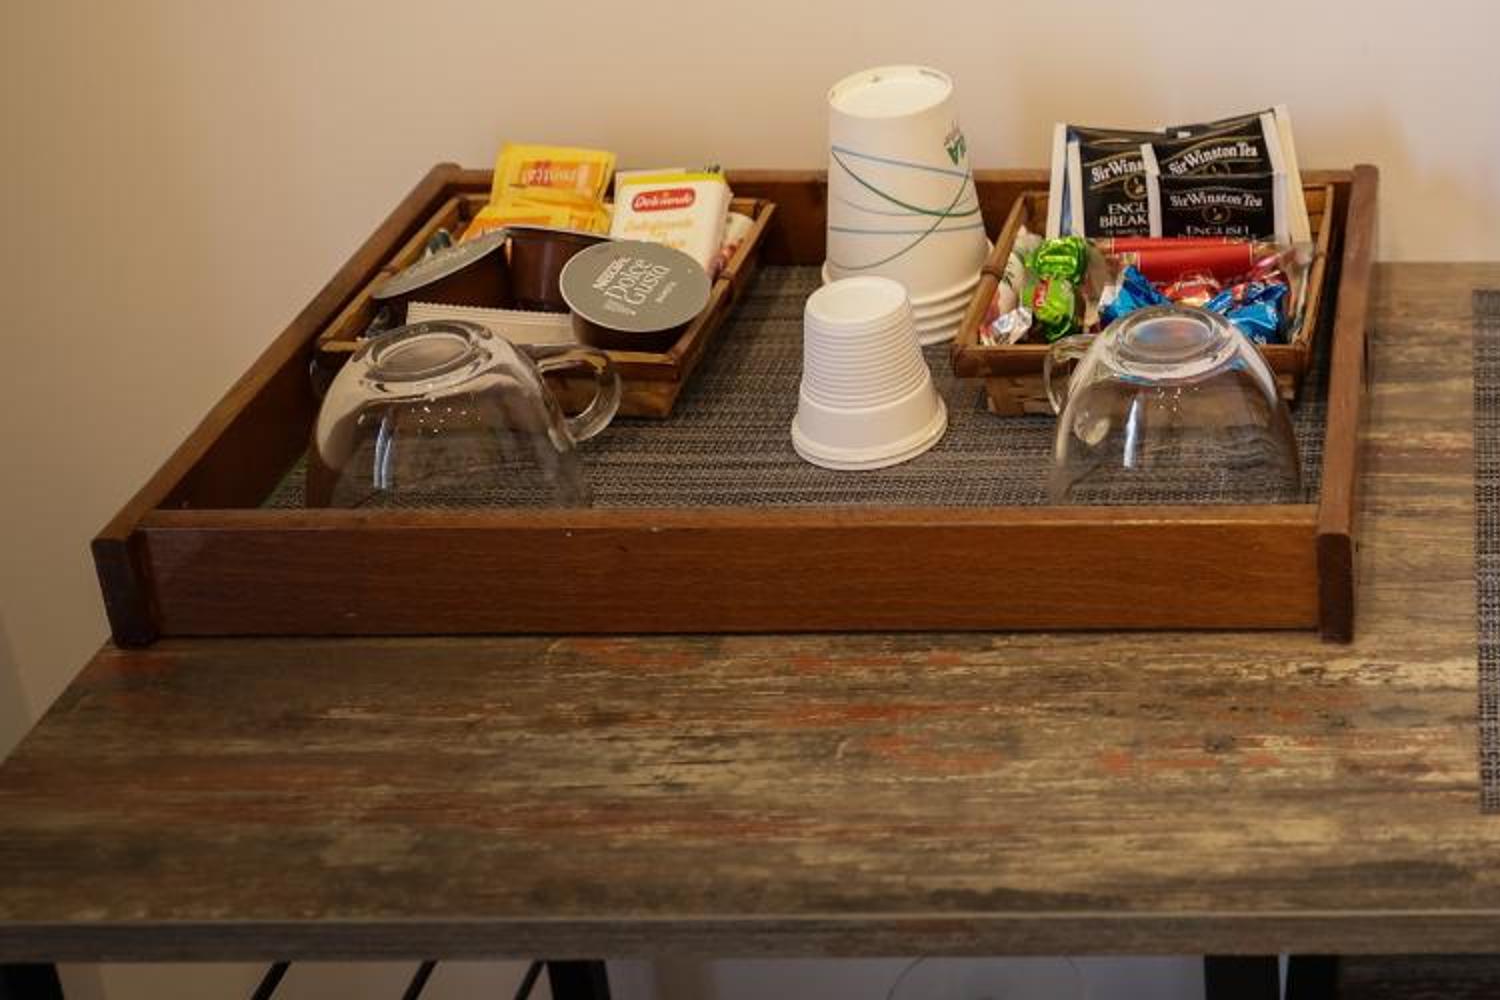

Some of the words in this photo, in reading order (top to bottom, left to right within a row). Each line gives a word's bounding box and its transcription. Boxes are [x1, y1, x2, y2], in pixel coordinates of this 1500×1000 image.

[1183, 147, 1237, 168] Winston
[1236, 142, 1259, 157] Tea
[1091, 165, 1110, 183] Sir
[1169, 194, 1188, 207] Sir
[1185, 191, 1242, 205] Winston
[1242, 192, 1263, 207] Tea
[603, 258, 653, 300] Dolce
[623, 265, 672, 306] Gusto
